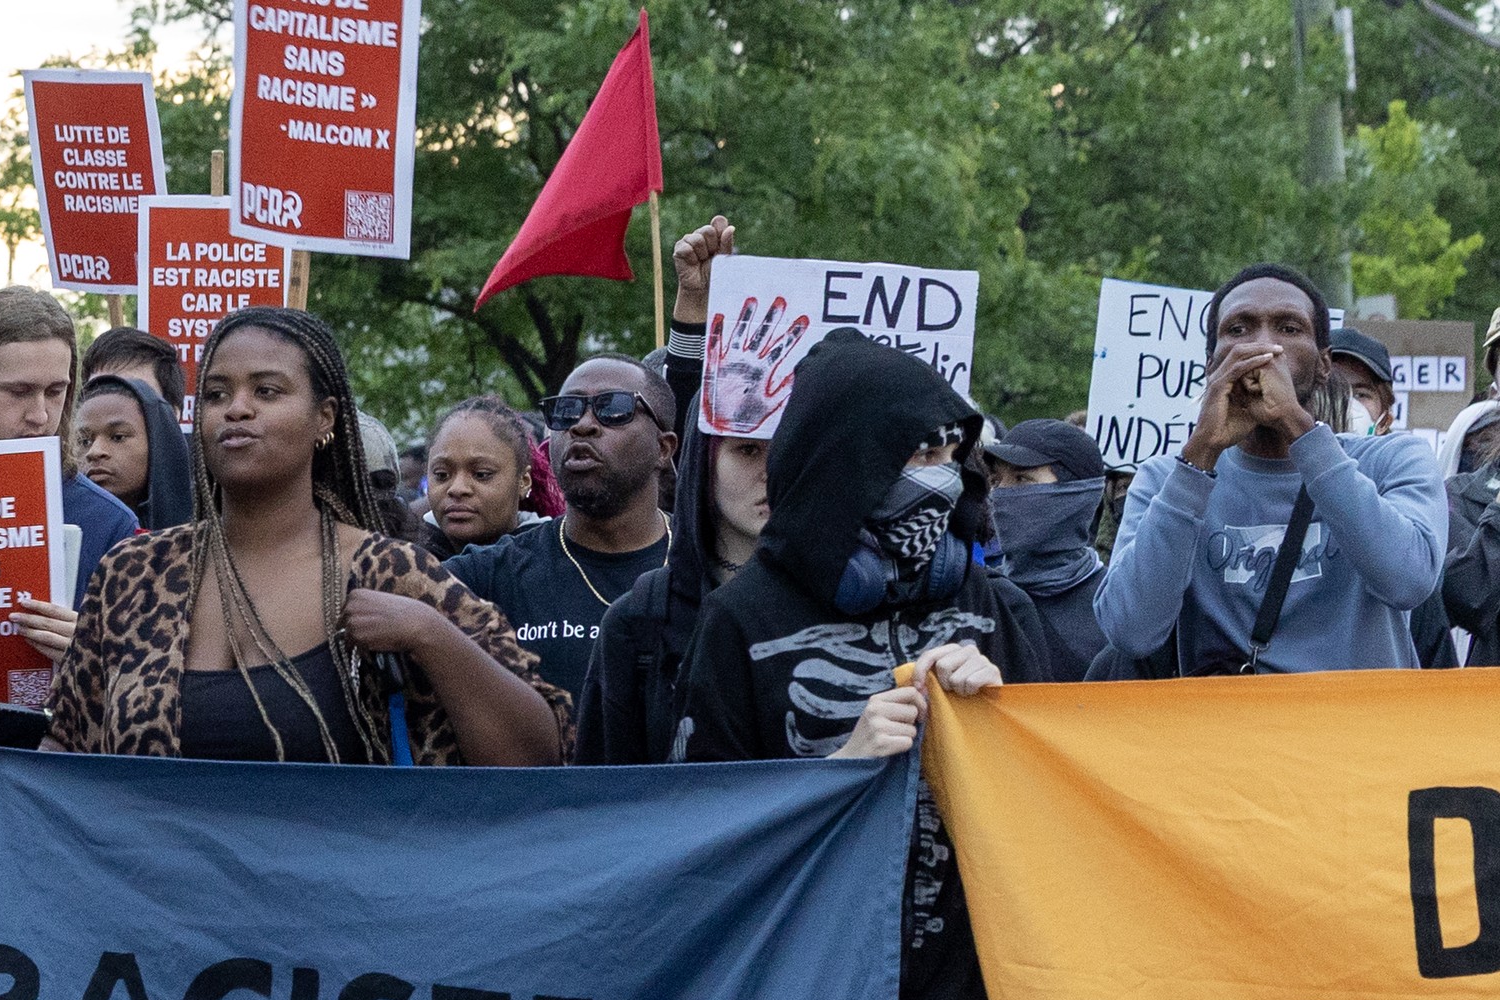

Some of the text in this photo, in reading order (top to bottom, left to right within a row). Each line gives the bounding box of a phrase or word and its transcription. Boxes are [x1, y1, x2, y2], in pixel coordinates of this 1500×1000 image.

[250, 5, 398, 48] CAPITALISME
[284, 44, 345, 76] SANS
[257, 73, 356, 112] RACISME
[54, 125, 130, 143] LUTTE DE
[376, 129, 391, 149] X
[63, 150, 127, 167] CLASSE
[54, 171, 143, 191] CONTRE LE
[64, 194, 139, 214] RACISME
[166, 243, 266, 262] LA POLICE
[153, 268, 280, 288] EST RACISTE
[181, 293, 223, 313] CAR
[822, 271, 963, 332] END
[563, 620, 585, 638] be
[589, 625, 600, 638] a
